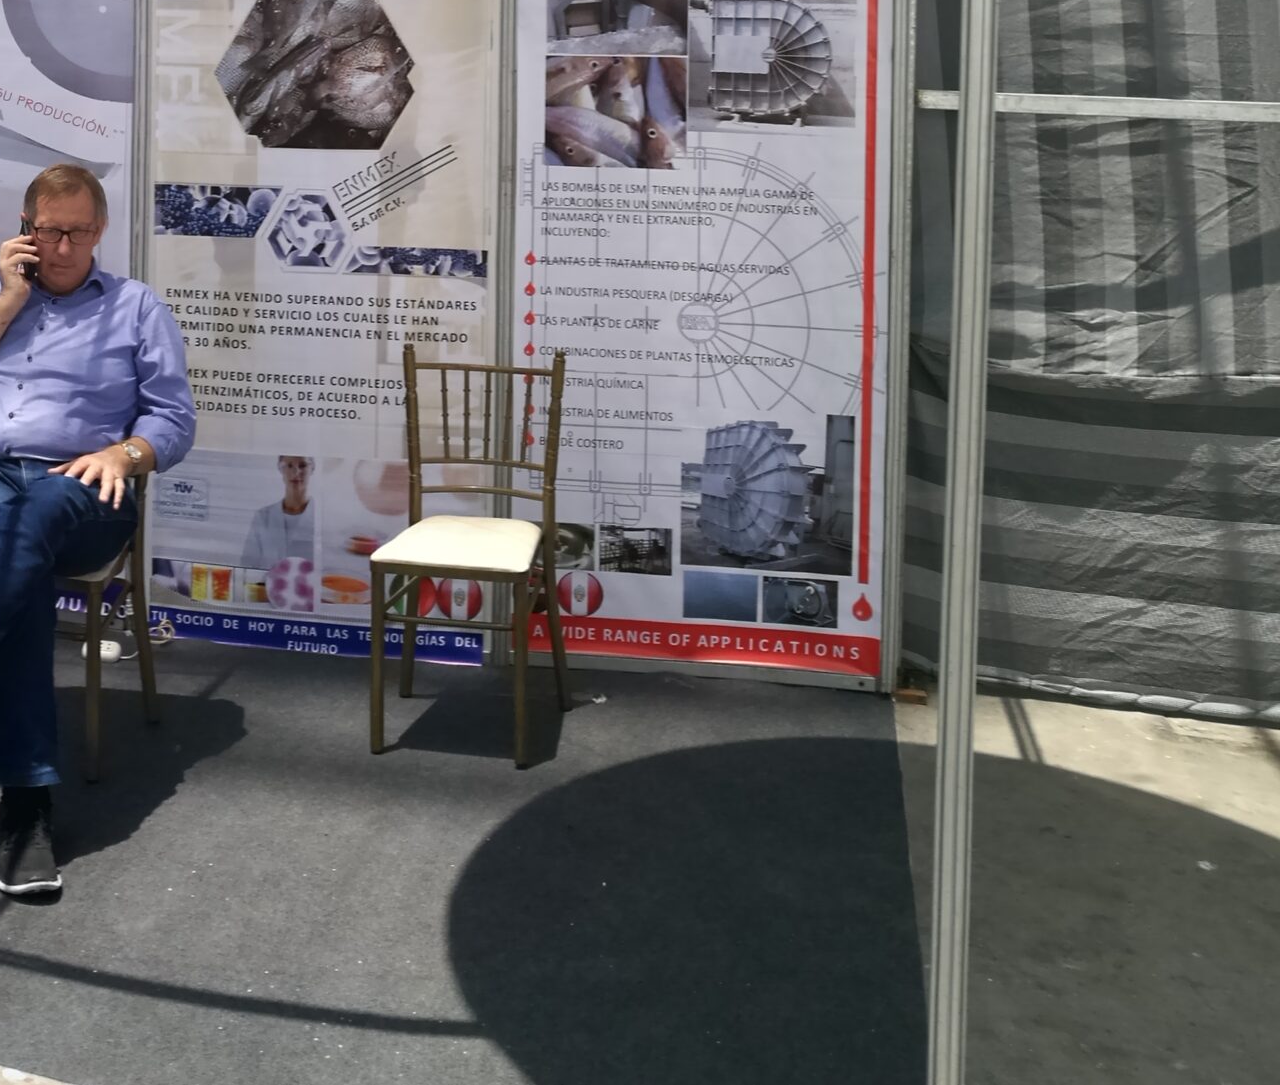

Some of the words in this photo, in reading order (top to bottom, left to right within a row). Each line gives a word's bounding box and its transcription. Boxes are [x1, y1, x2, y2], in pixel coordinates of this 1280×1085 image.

[540, 227, 611, 239] INCLUYENDO:
[166, 288, 210, 300] ENMEX
[213, 290, 231, 301] HA
[235, 291, 283, 303] VENIDO
[287, 293, 364, 307] SUPERANDO
[368, 296, 392, 308] SUS
[395, 296, 477, 312] ESTÁNDARES
[539, 285, 552, 296] LA
[554, 285, 610, 299] INDUSTRIA
[612, 288, 667, 301] PESQUERA
[669, 290, 734, 304] (DESCARGA)
[539, 316, 556, 326] LAS
[558, 317, 603, 328] PLANTAS
[605, 318, 621, 329] DE
[623, 319, 659, 331] CARNE
[151, 610, 168, 621] TU
[175, 613, 214, 628] SOCIO
[223, 617, 240, 630] DE
[248, 621, 275, 634] HOY
[283, 624, 317, 638] PARA
[326, 627, 350, 640] LAS
[357, 631, 446, 646] TENOLGÍAS
[454, 636, 479, 648] DEL
[287, 640, 339, 655] FUTURO
[533, 624, 544, 638] A
[603, 628, 662, 646] RANGE
[667, 632, 691, 647] OF
[697, 634, 861, 661] APPLICATIONS
